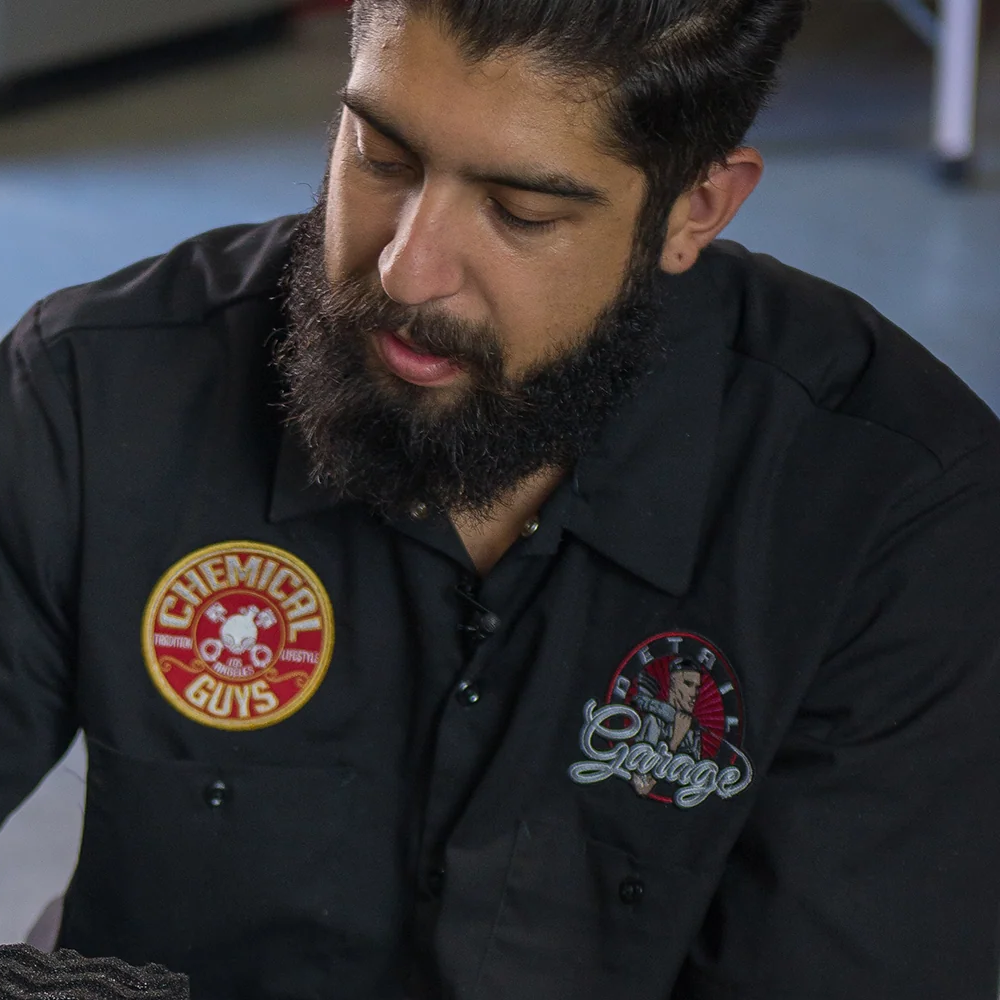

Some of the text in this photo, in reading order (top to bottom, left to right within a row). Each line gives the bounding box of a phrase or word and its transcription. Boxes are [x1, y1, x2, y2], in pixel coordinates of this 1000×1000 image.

[158, 555, 322, 643] CHEMICAL
[154, 633, 193, 650] TRADITION
[280, 648, 319, 664] LIFESTYLE
[185, 674, 279, 718] GUYS
[568, 698, 752, 807] Garage
